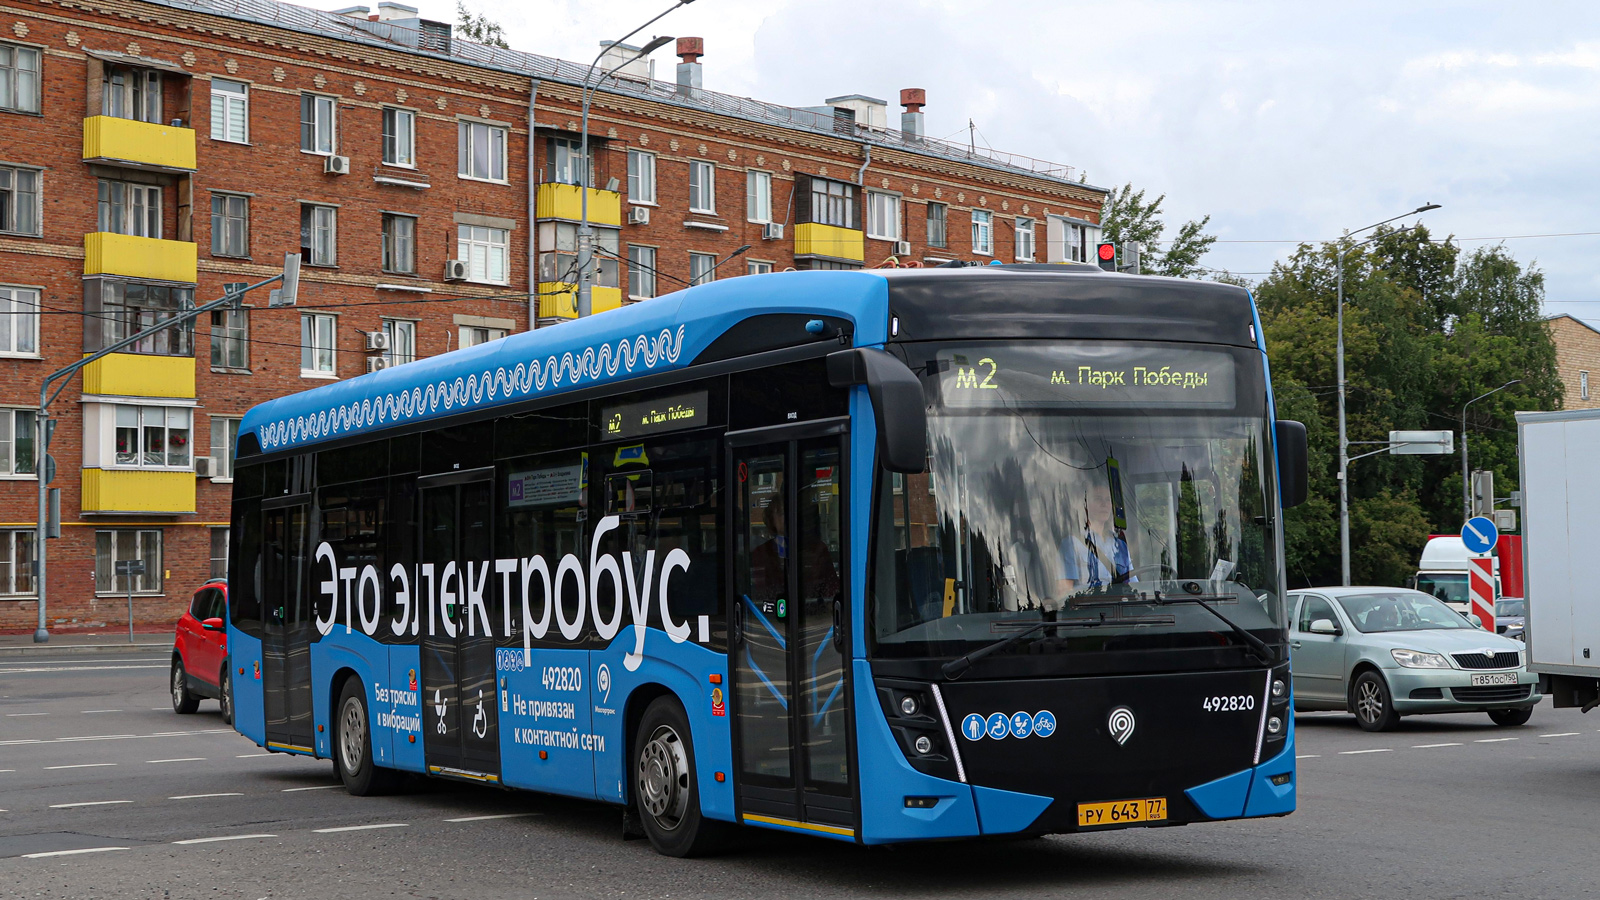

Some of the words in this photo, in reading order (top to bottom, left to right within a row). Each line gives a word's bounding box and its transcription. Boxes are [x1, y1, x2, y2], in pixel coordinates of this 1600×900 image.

[955, 357, 998, 389] м2
[1050, 370, 1070, 385] м.
[1078, 366, 1126, 389] Парк
[1133, 366, 1208, 388] Победы
[315, 541, 381, 636] Это
[390, 515, 710, 672] электробус.
[542, 666, 582, 692] 492820
[374, 682, 389, 703] Без
[389, 689, 418, 708] тряски
[513, 694, 527, 716] Не
[528, 700, 575, 721] привязан
[1203, 695, 1255, 712] 492820
[382, 709, 421, 733] вибраций
[514, 727, 521, 744] к
[522, 727, 579, 749] контактной
[580, 733, 605, 752] сети
[1086, 808, 1104, 823] РУ
[1111, 802, 1140, 821] 643
[1148, 800, 1162, 814] 77
